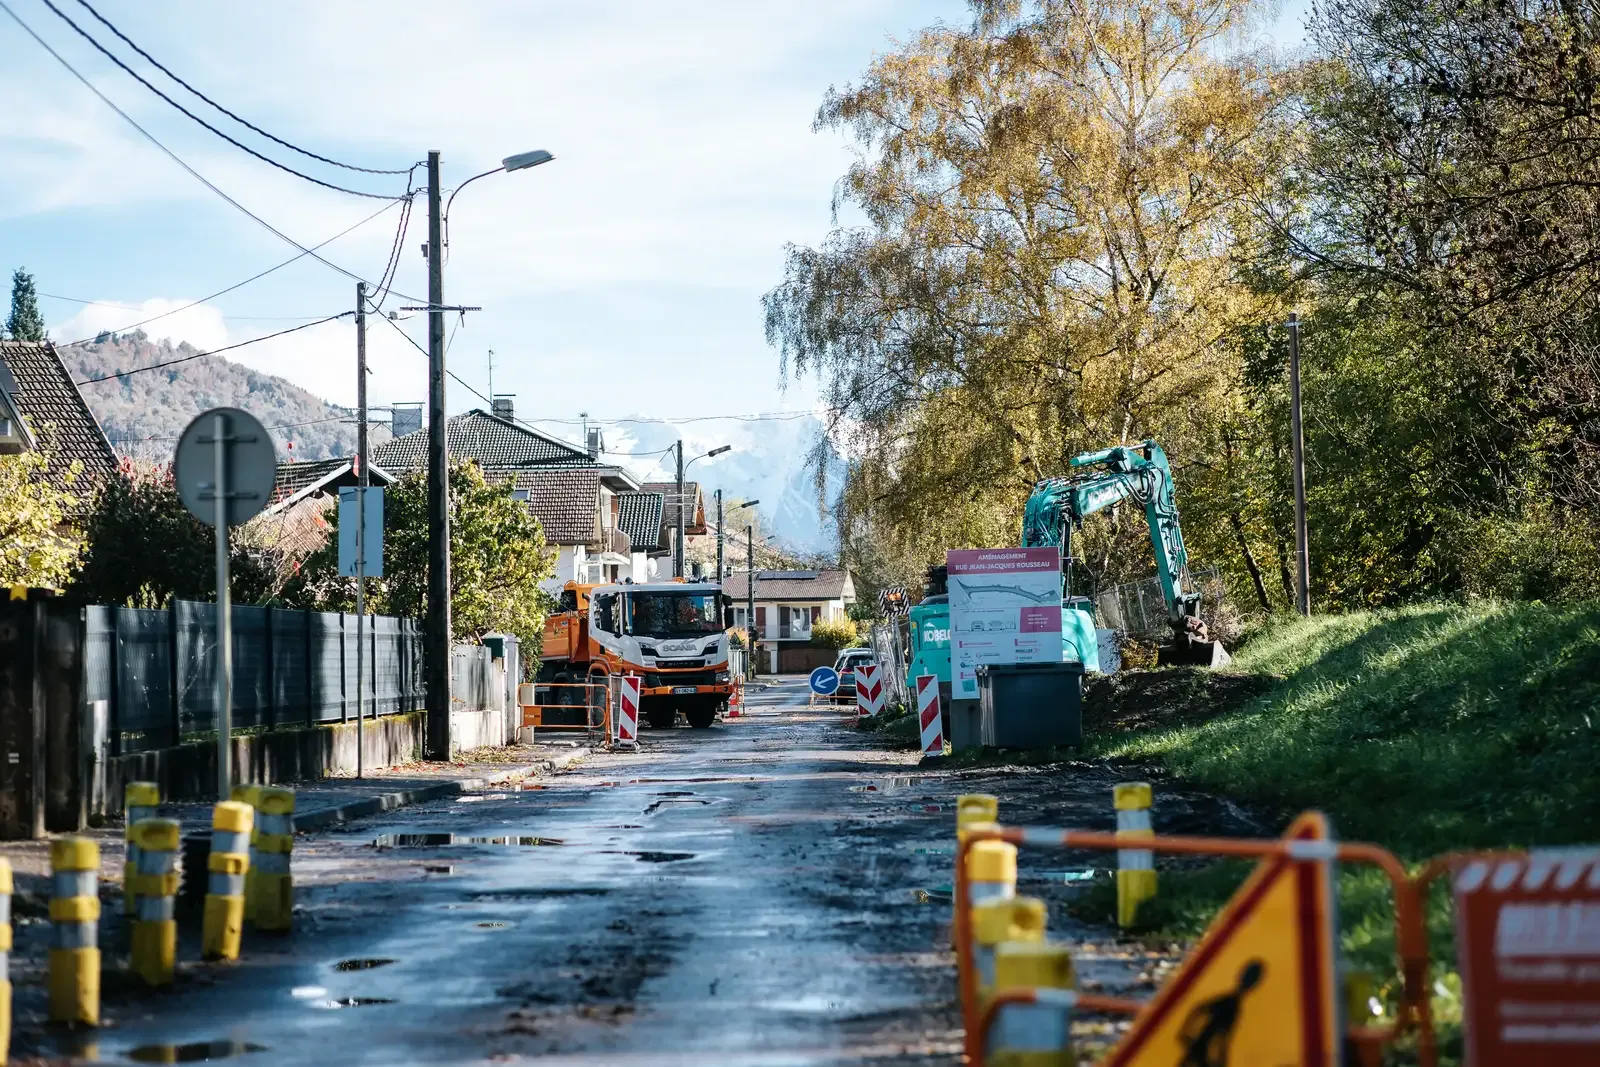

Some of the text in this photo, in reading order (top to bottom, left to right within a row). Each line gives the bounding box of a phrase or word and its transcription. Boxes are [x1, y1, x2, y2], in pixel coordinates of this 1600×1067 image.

[978, 552, 1027, 561] AMÉNAGEMENT
[968, 562, 1015, 571] JEAN-JACQUES
[1016, 561, 1050, 569] ROUSSEAU
[662, 643, 698, 652] SCANIA
